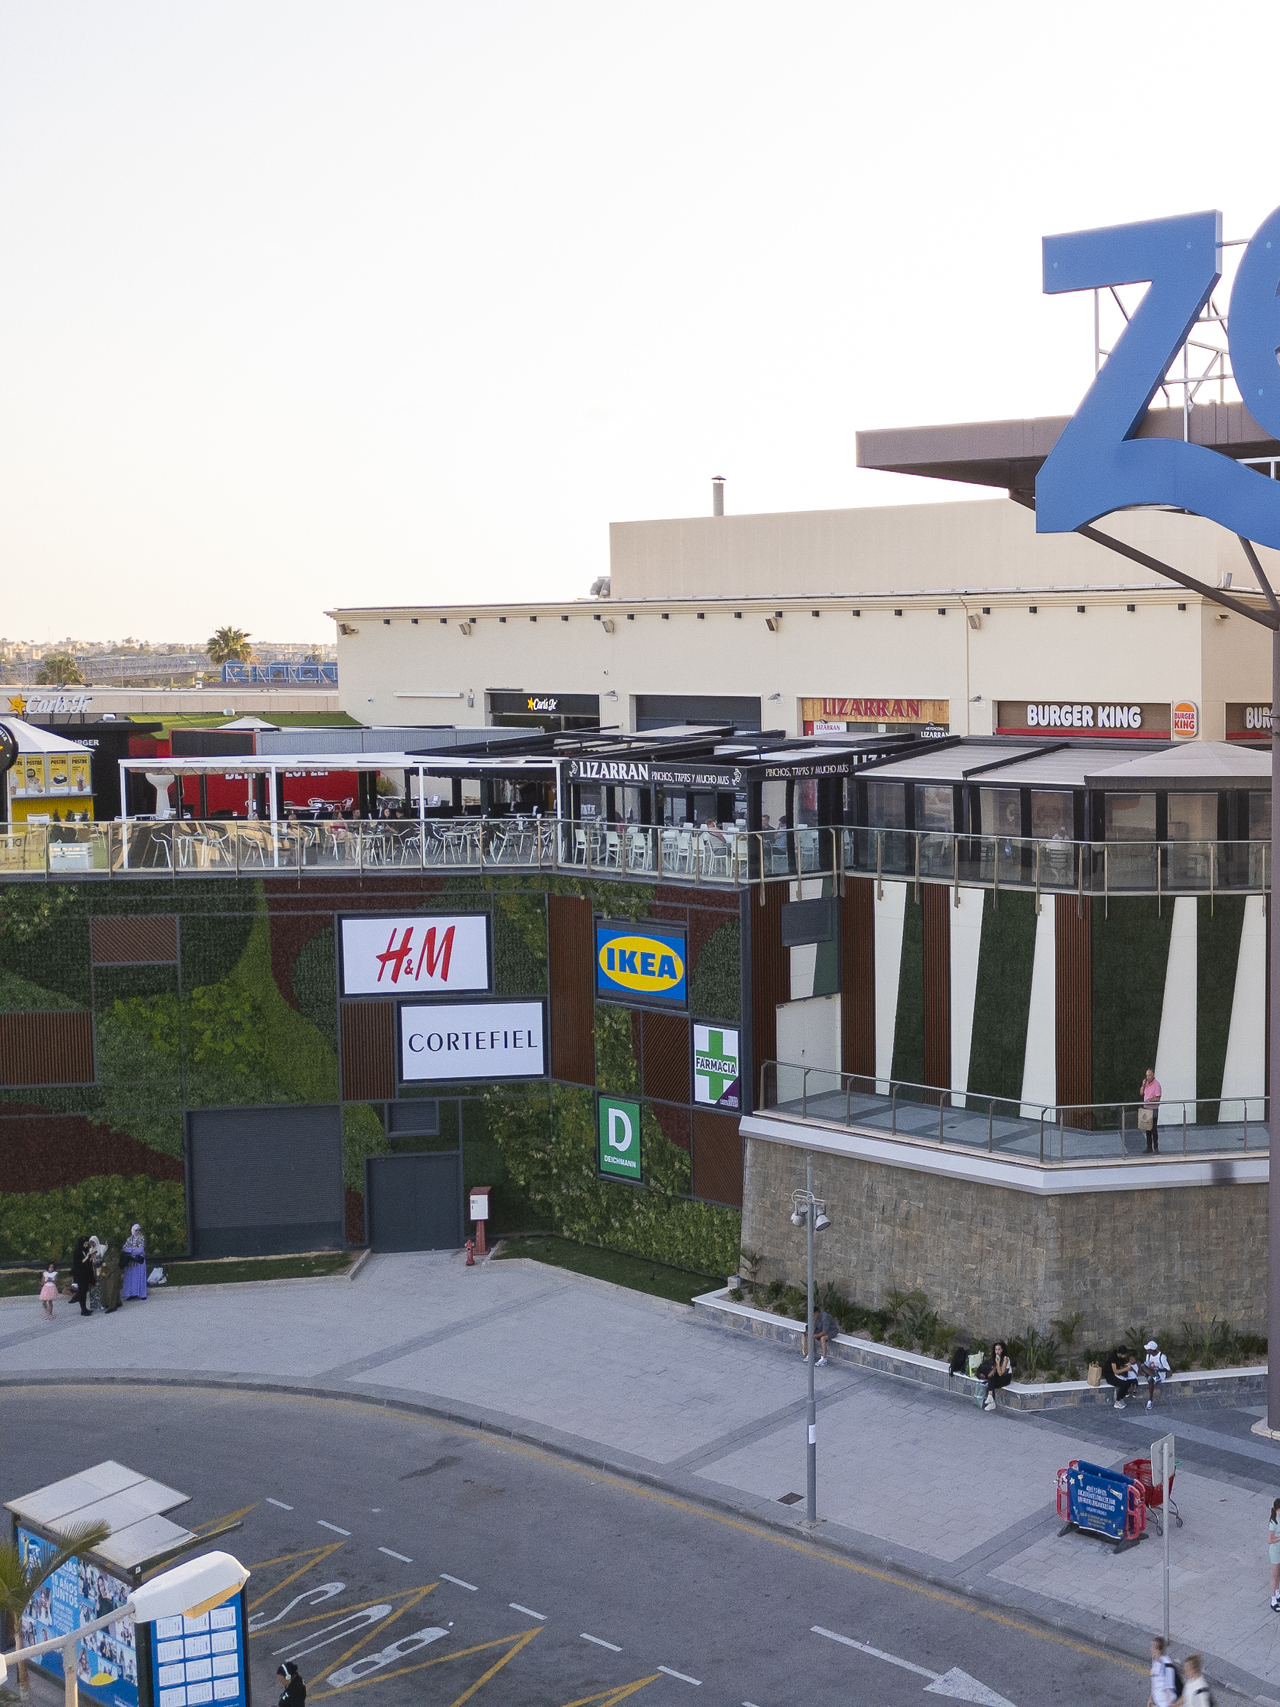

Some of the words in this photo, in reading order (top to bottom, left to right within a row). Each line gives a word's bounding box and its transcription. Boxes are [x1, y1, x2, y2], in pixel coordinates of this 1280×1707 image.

[26, 695, 68, 714] Carl's
[533, 698, 548, 710] Carl's
[822, 698, 922, 718] LIZARRAN
[1027, 704, 1094, 727] BURGER
[1097, 705, 1142, 728] KING
[1174, 712, 1195, 720] BURGER
[1174, 720, 1195, 730] KING
[1246, 706, 1273, 729] BUR
[579, 761, 649, 780] LIZARRAN
[376, 925, 456, 984] H&M
[605, 947, 679, 981] IKEA
[408, 1029, 538, 1053] CORTEFIEL
[696, 1057, 737, 1075] FARMACIA
[608, 1107, 633, 1153] D
[604, 1154, 637, 1169] DEICHMANN
[51, 1584, 79, 1608] JUNTOS
